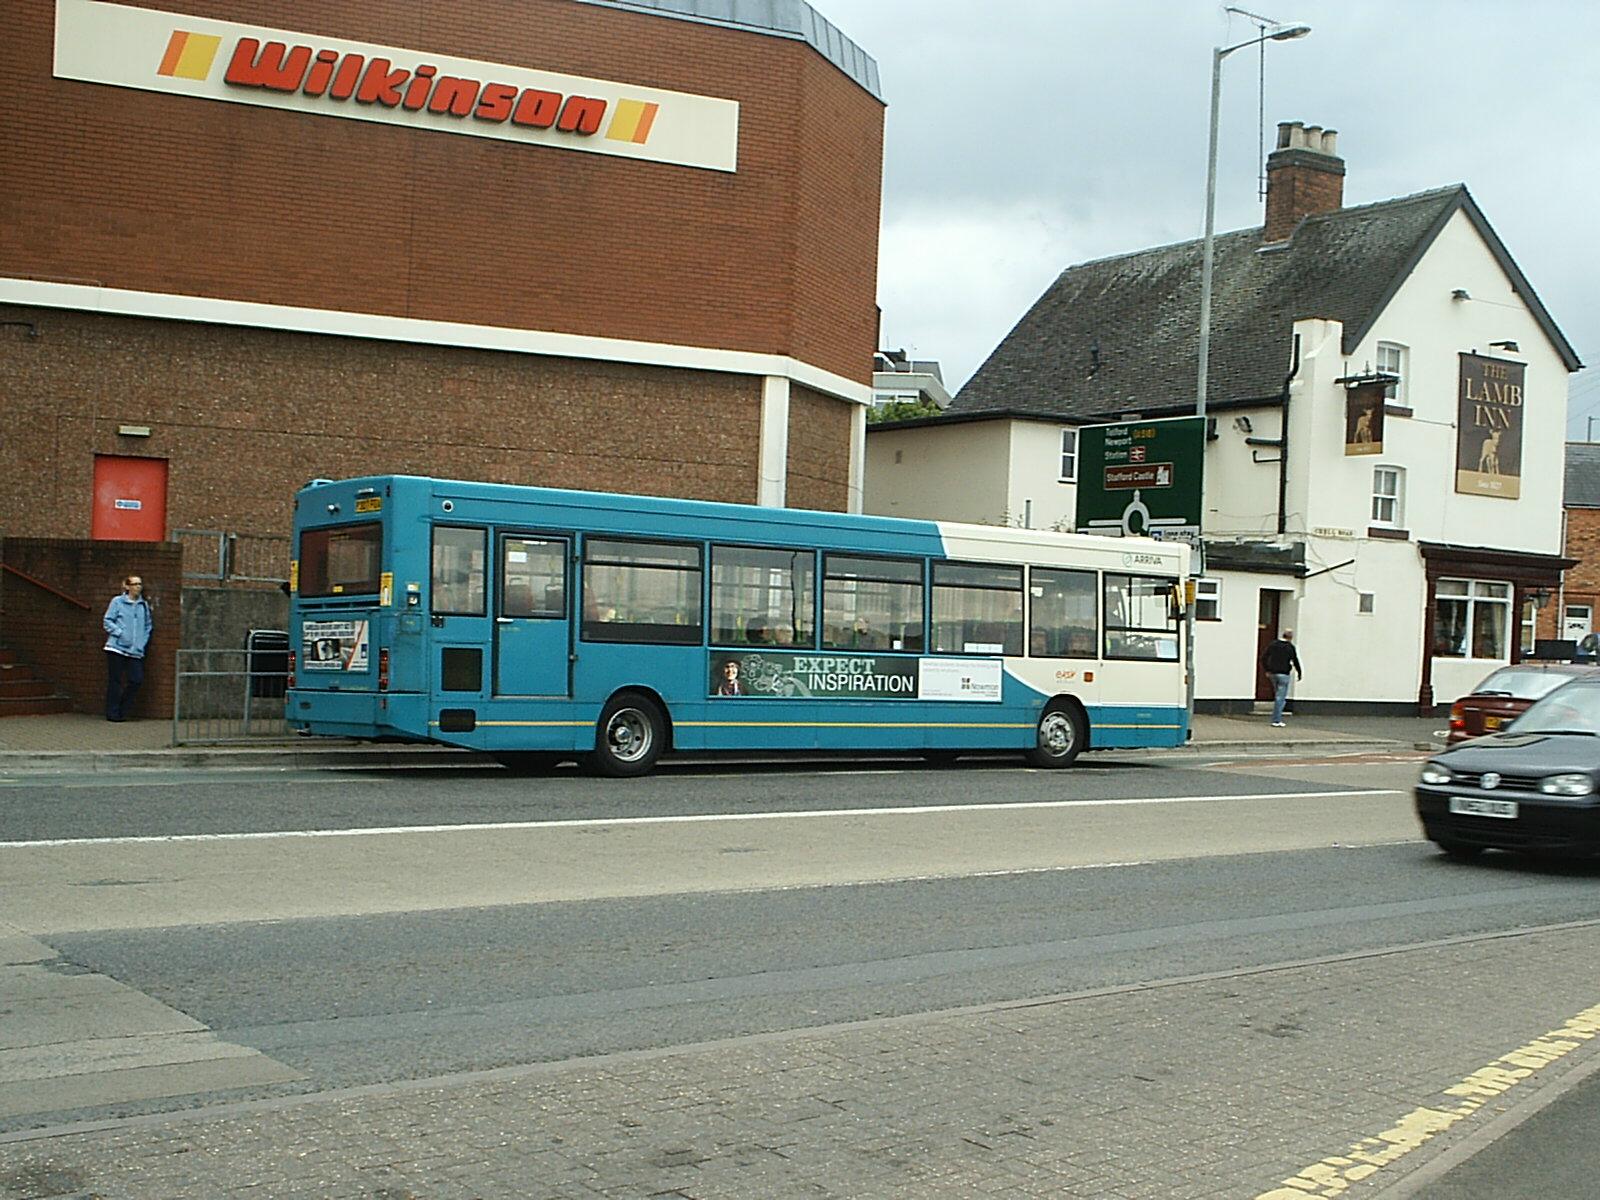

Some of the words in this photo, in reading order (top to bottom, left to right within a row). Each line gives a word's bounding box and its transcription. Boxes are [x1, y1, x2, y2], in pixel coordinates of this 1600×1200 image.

[223, 37, 608, 136] Wilkinson
[1482, 363, 1508, 380] THE
[1466, 377, 1522, 407] LAMB
[1475, 405, 1512, 429] INN
[1134, 555, 1163, 565] ARRIVA
[793, 656, 876, 675] EXPECT
[808, 673, 915, 693] INSPIRATION
